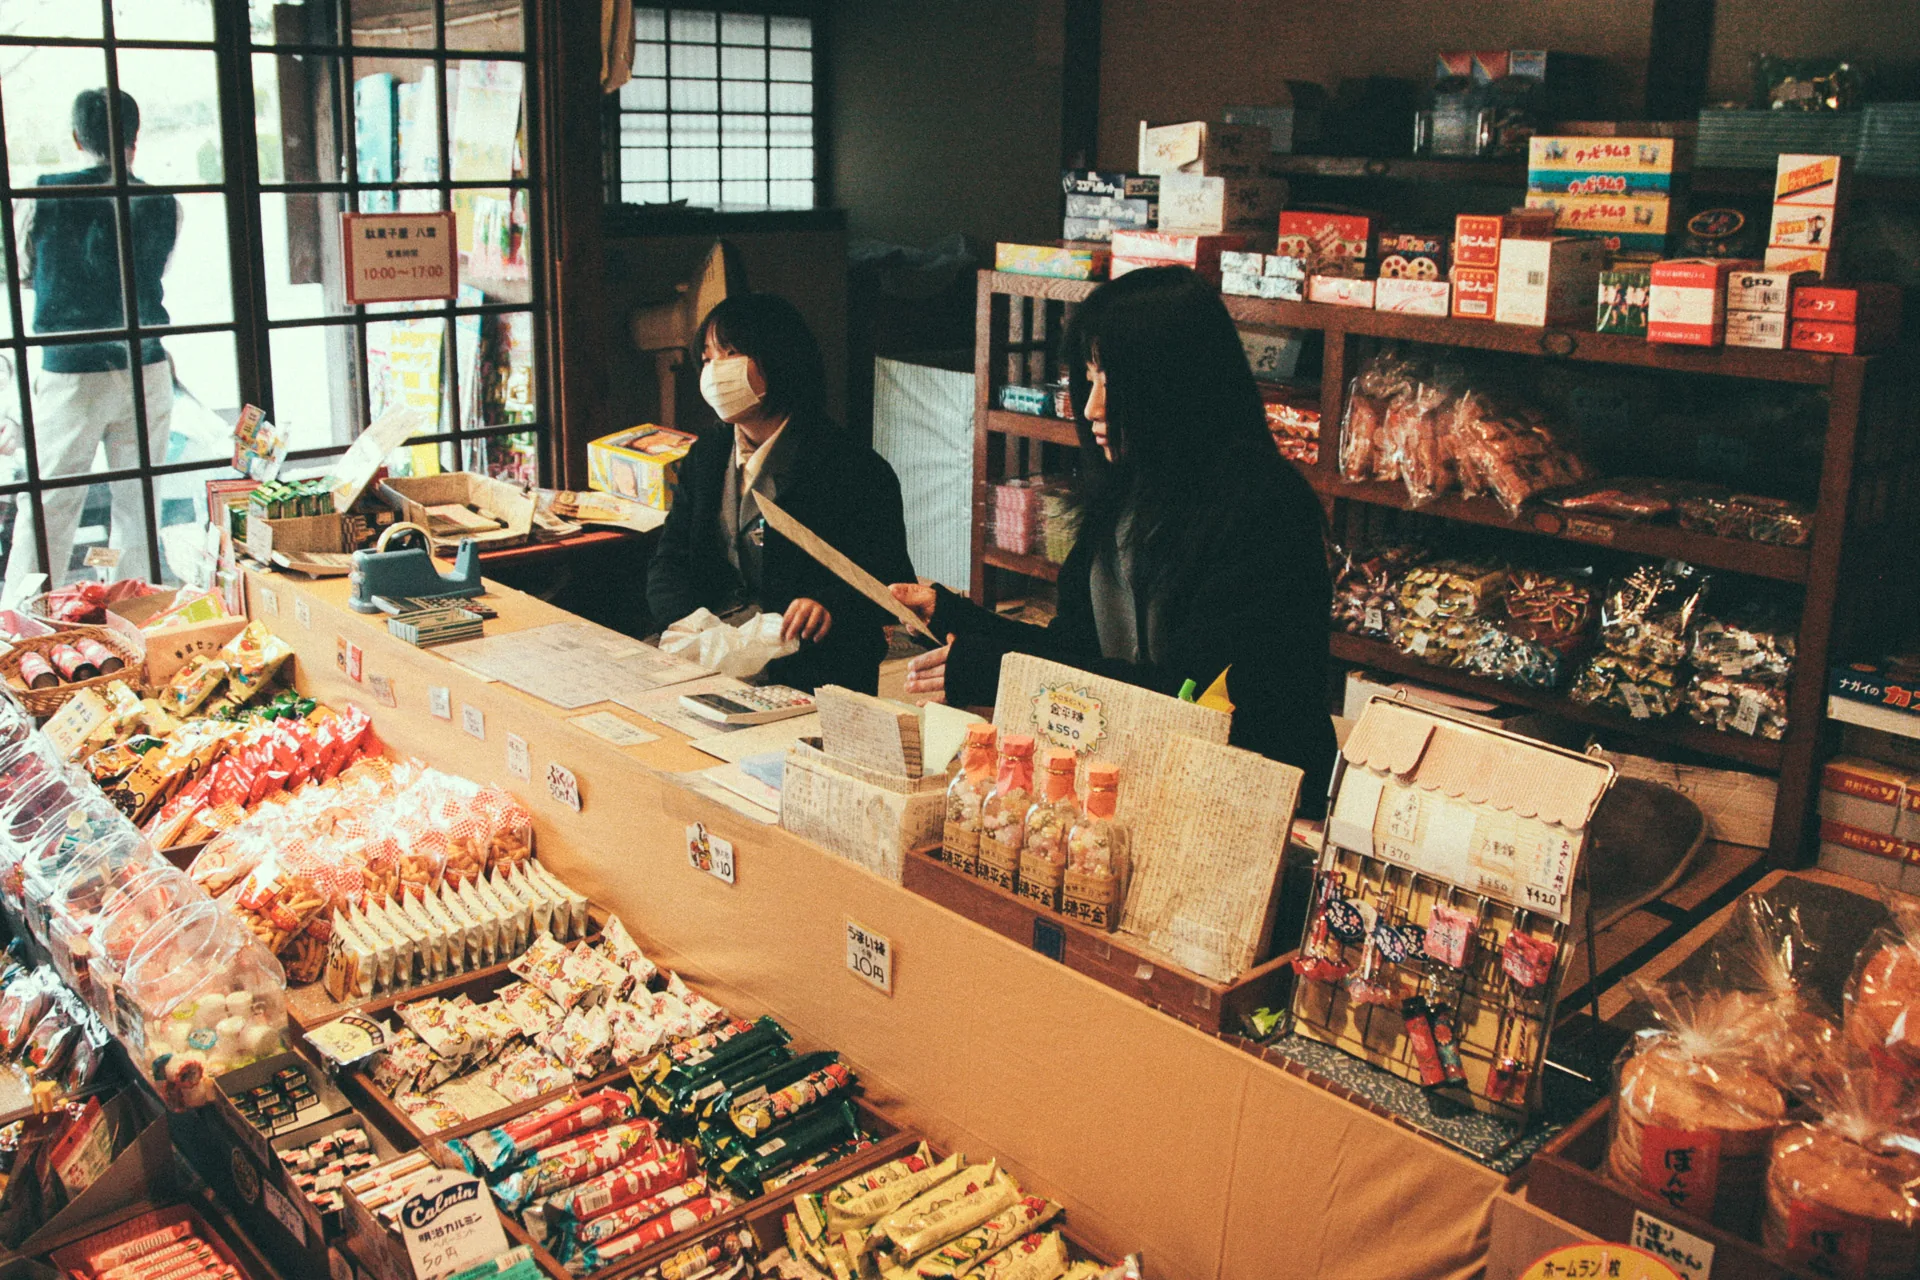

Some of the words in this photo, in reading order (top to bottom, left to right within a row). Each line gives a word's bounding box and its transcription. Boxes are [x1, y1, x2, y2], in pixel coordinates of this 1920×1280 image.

[1839, 678, 1880, 697] ナガイの
[1525, 885, 1557, 906] ¥420
[852, 952, 885, 984] 10円
[410, 1185, 476, 1228] Calmin
[418, 1212, 483, 1243] 明治カルミン
